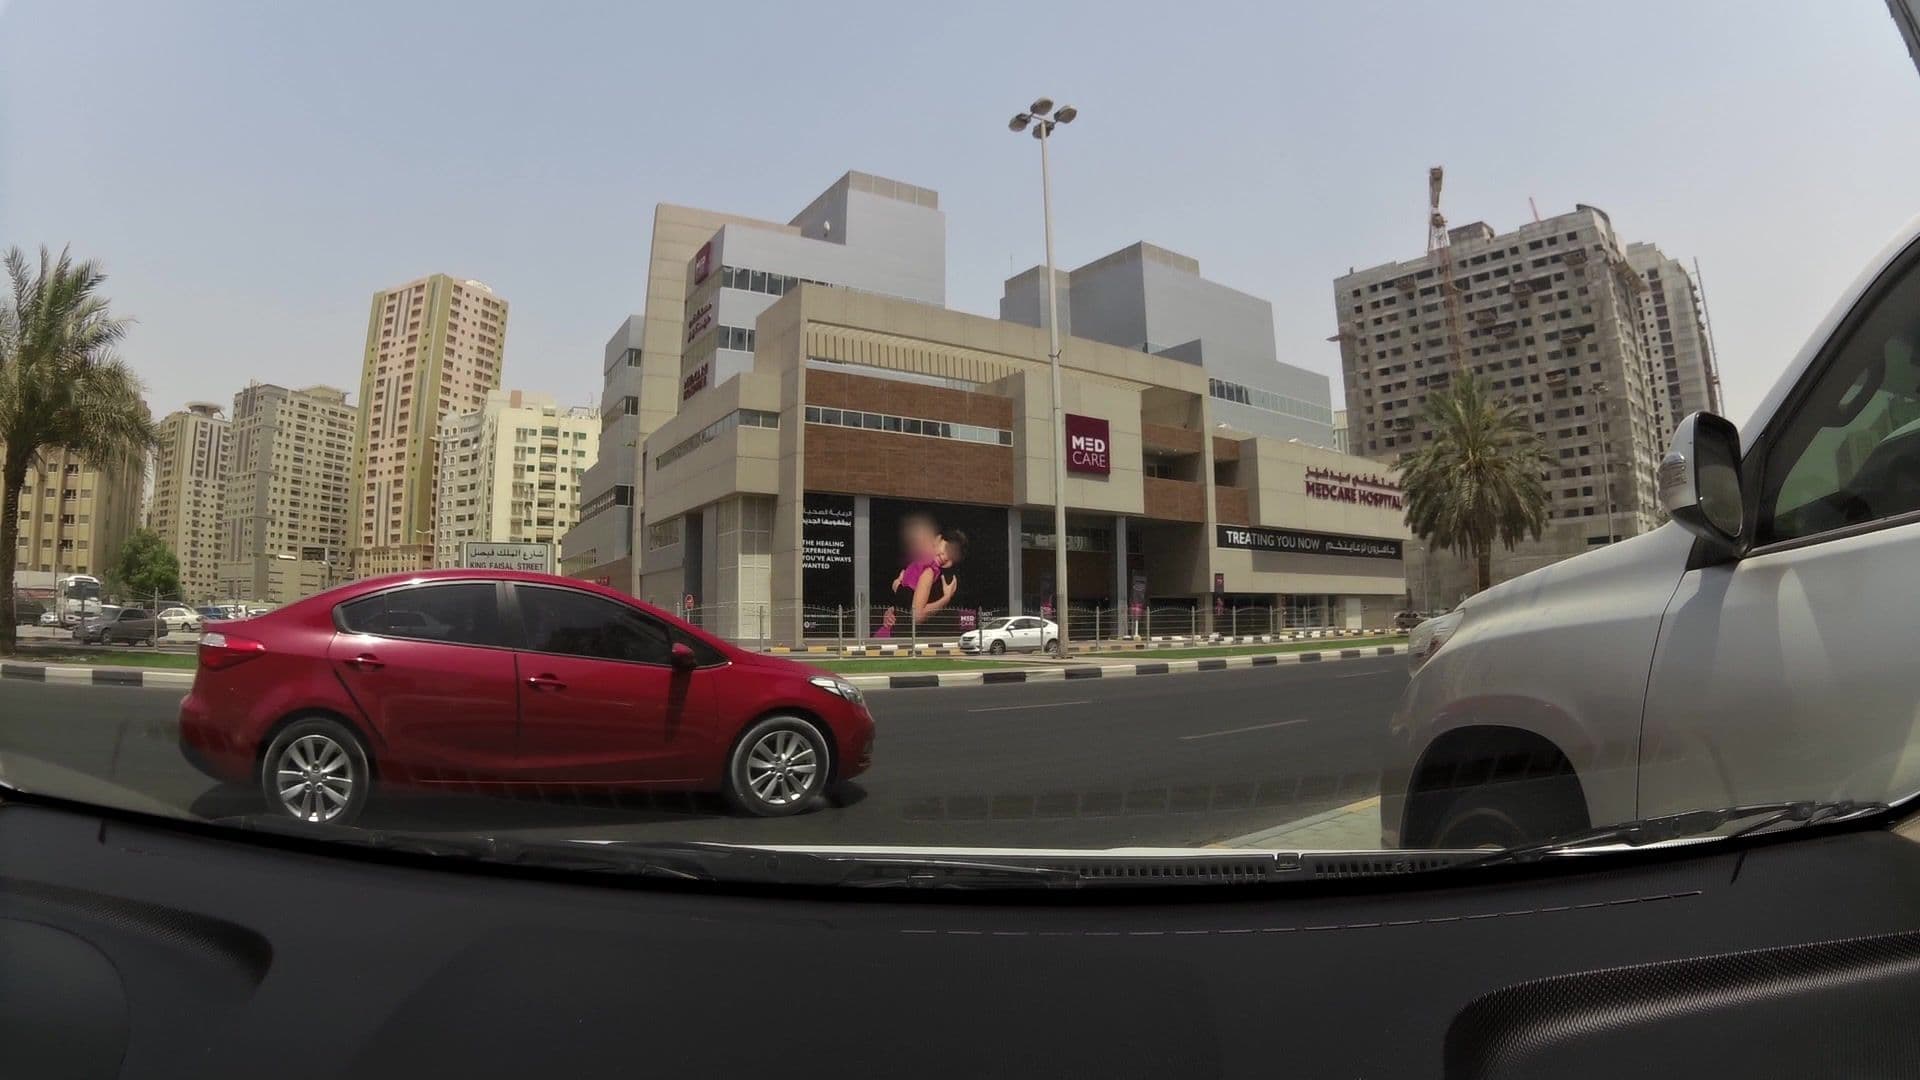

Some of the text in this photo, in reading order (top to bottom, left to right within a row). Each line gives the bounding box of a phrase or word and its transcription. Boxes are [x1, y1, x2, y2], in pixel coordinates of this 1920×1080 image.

[1072, 435, 1105, 452] MED
[1073, 451, 1105, 468] CARE
[1306, 481, 1402, 511] MEDCARE HOSPITAL
[1226, 530, 1320, 550] TREATING YOU NOW
[470, 548, 544, 560] شارع الملك فيصل
[489, 562, 513, 570] FAISAL
[517, 563, 544, 571] STREET
